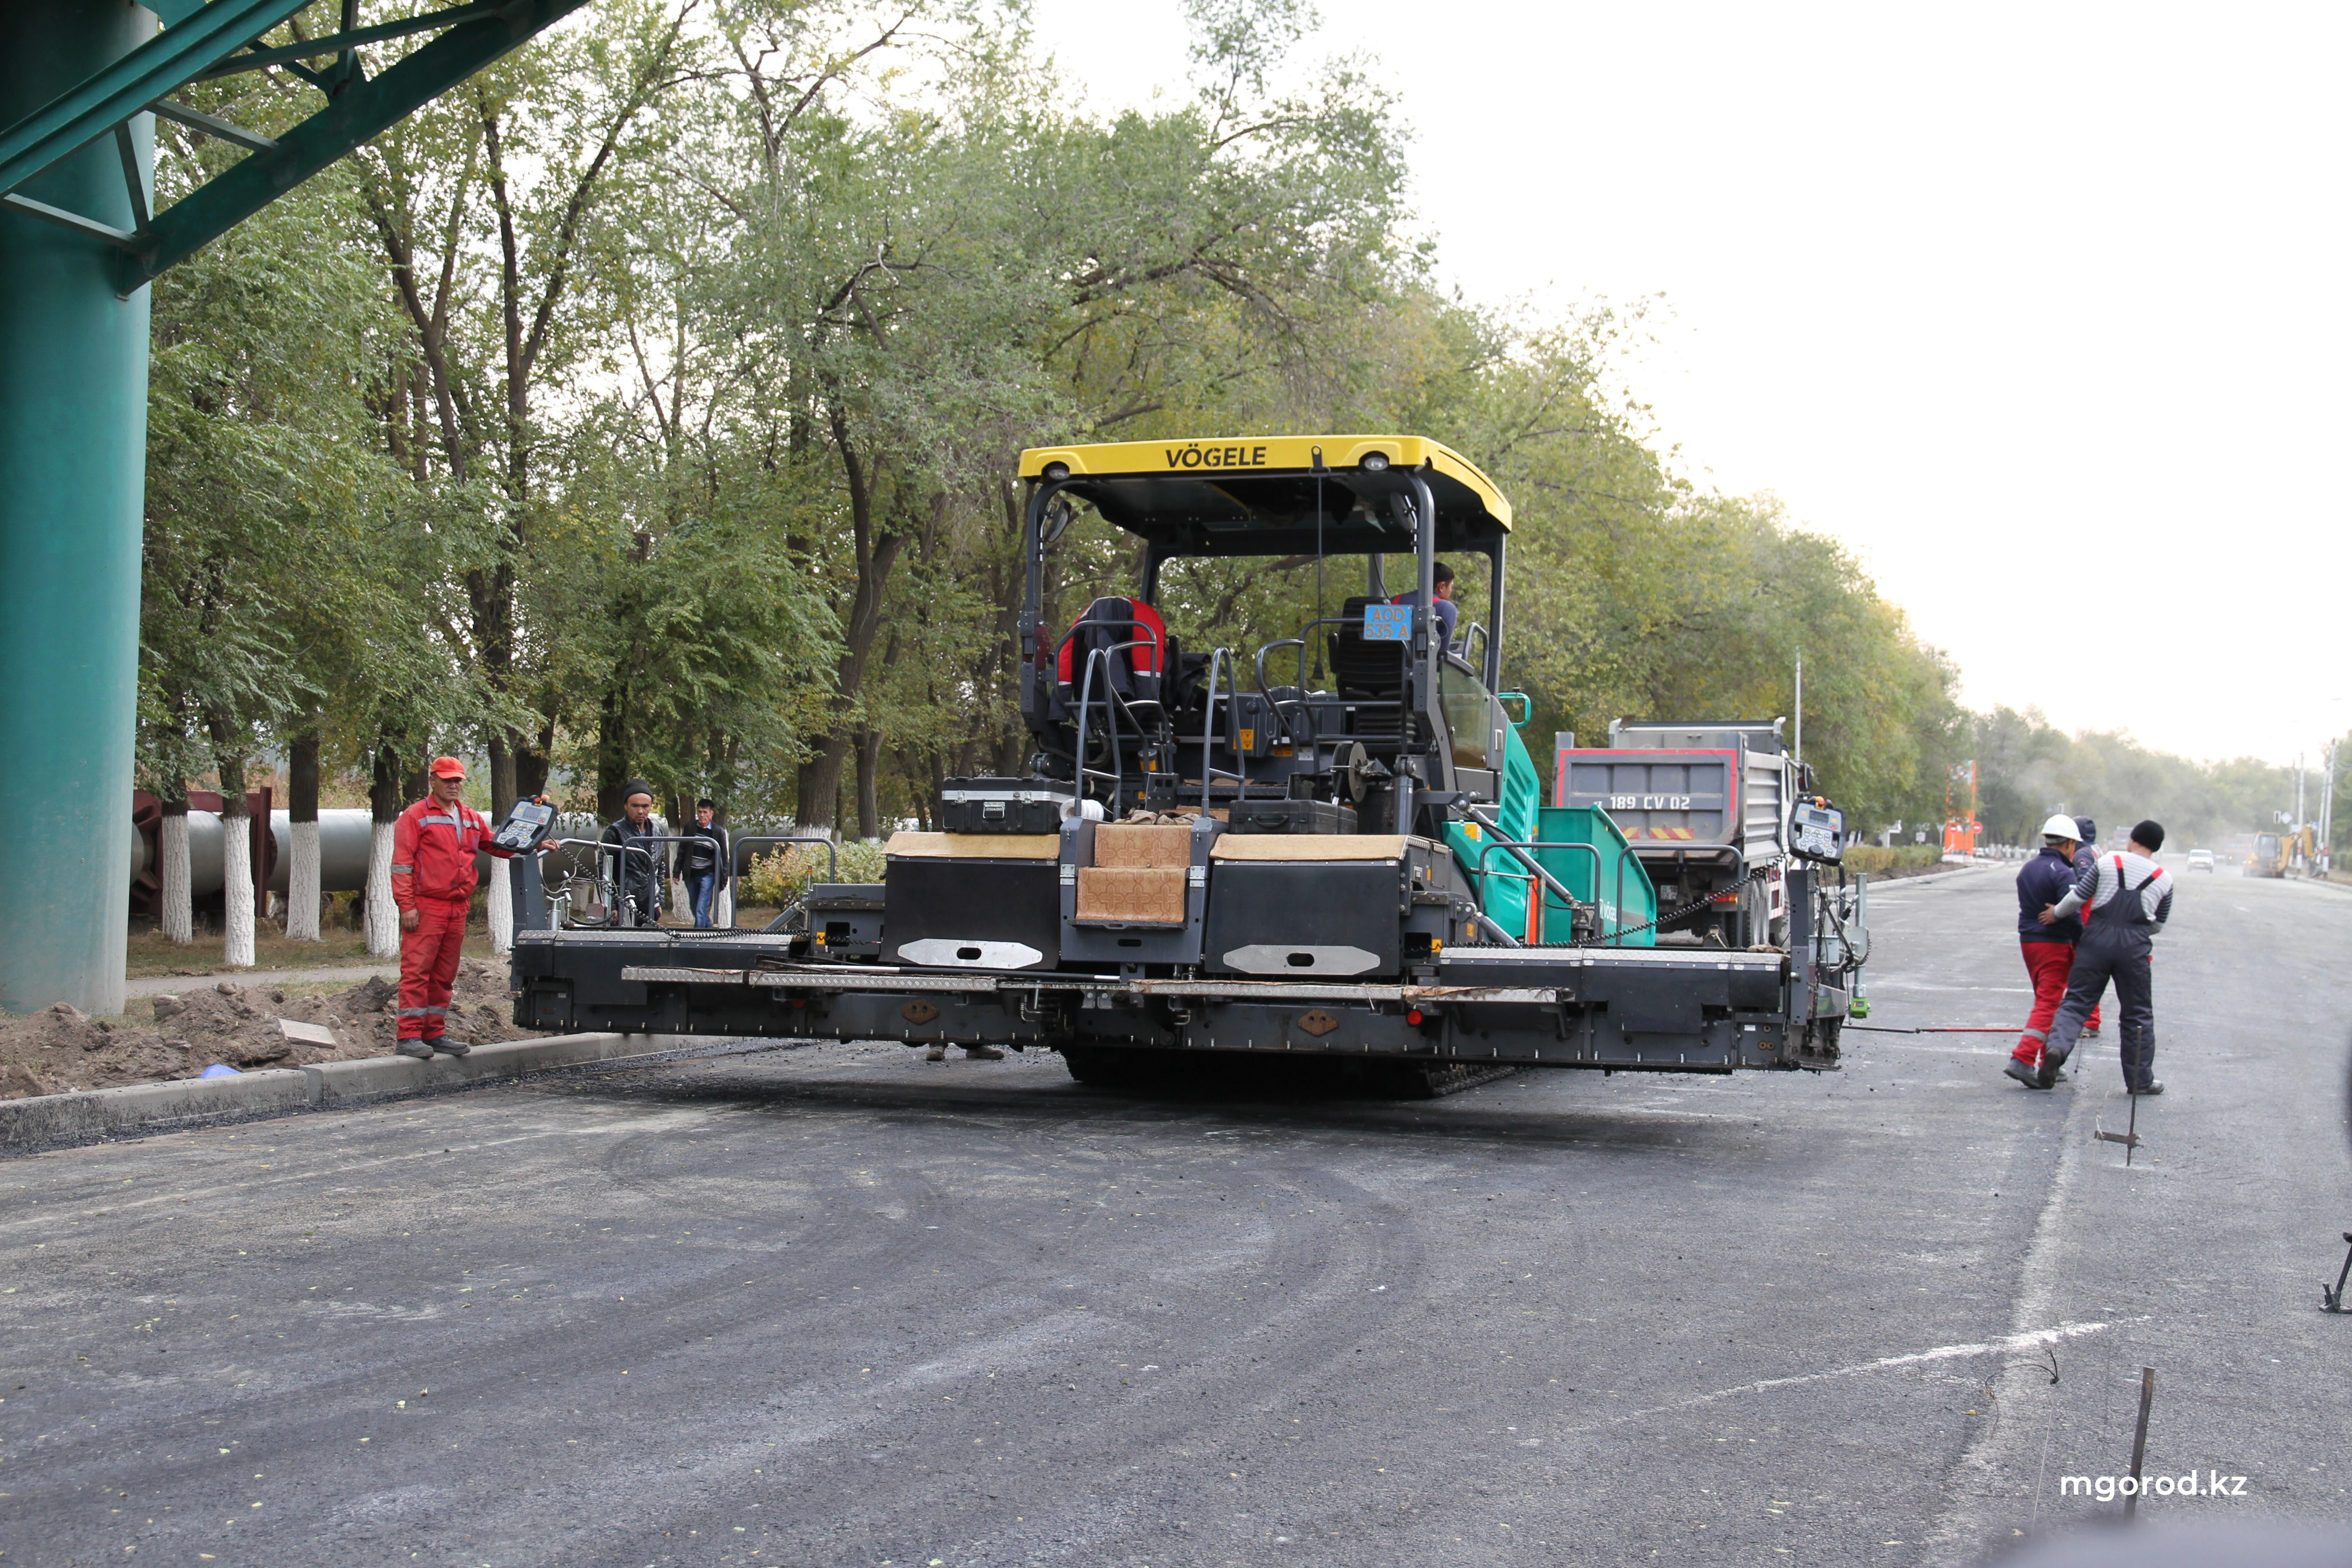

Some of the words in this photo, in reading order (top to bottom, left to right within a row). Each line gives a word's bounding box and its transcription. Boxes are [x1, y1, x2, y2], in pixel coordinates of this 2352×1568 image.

[1166, 443, 1266, 468] VÖGELE
[1366, 623, 1393, 638] 535
[1398, 623, 1409, 638] A
[1610, 796, 1636, 810] 189
[1643, 796, 1664, 810] CV
[1670, 796, 1690, 810] 02
